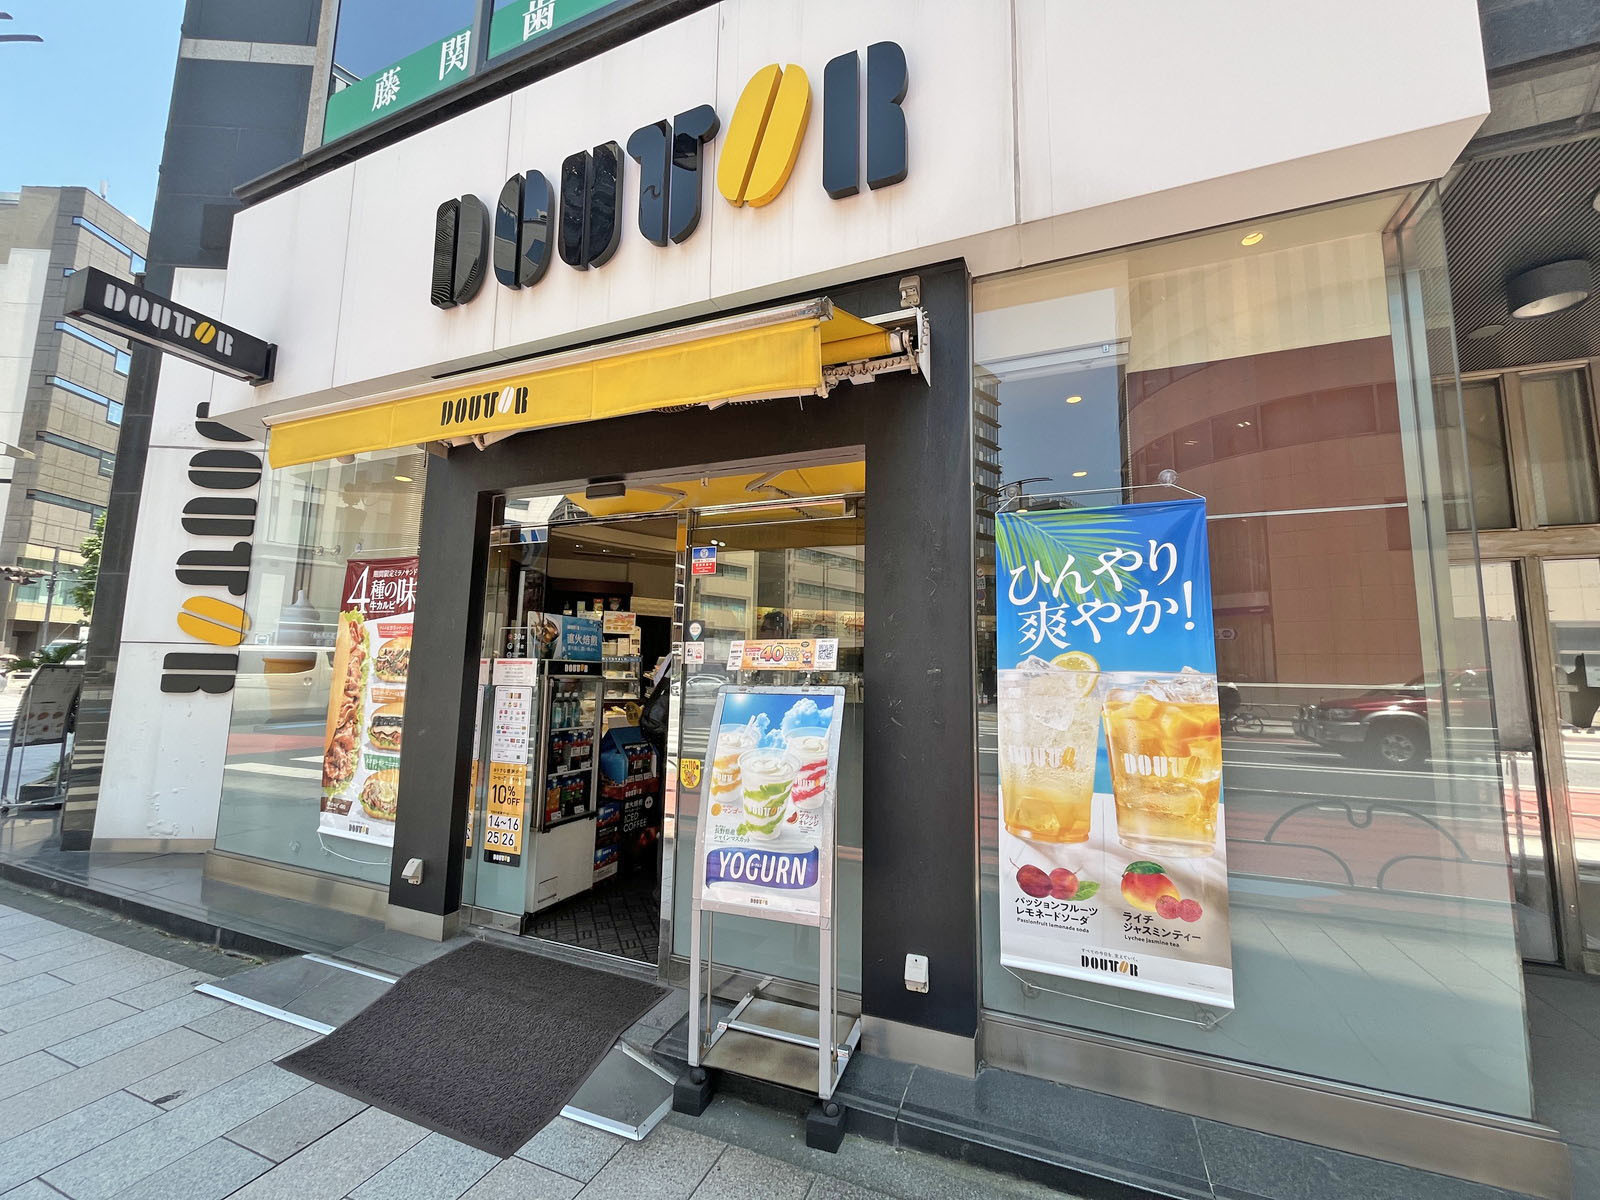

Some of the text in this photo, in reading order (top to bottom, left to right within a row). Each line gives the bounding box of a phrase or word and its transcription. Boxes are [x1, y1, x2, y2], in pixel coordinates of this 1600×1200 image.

[430, 40, 909, 310] DOUTOR
[103, 283, 235, 357] DOUTOR
[440, 386, 529, 426] DOUTOR
[1008, 539, 1178, 606] ひんやり
[369, 600, 396, 610] 牛カルビ
[760, 645, 785, 662] 40
[564, 663, 588, 673] DOUTOR
[1123, 753, 1203, 778] DOUTO
[492, 784, 520, 806] 10% OFF
[624, 811, 639, 824] ICED
[722, 806, 742, 814] マンゴー
[799, 813, 820, 822] ブラッド
[623, 817, 648, 833] COFFEE
[487, 831, 514, 846] 25 26
[719, 851, 808, 886] YOGURN
[1015, 896, 1098, 916] パッションフルーツ
[1016, 905, 1090, 926] レモネードソーダ
[1016, 917, 1048, 927] Passionfruit
[1049, 922, 1076, 931] lemonade
[1123, 911, 1154, 924] ライチ
[1123, 922, 1201, 942] ジャスミンティー
[1124, 934, 1145, 942] Lychee
[1145, 937, 1169, 946] jasmine
[1081, 955, 1138, 977] DOUTOR
